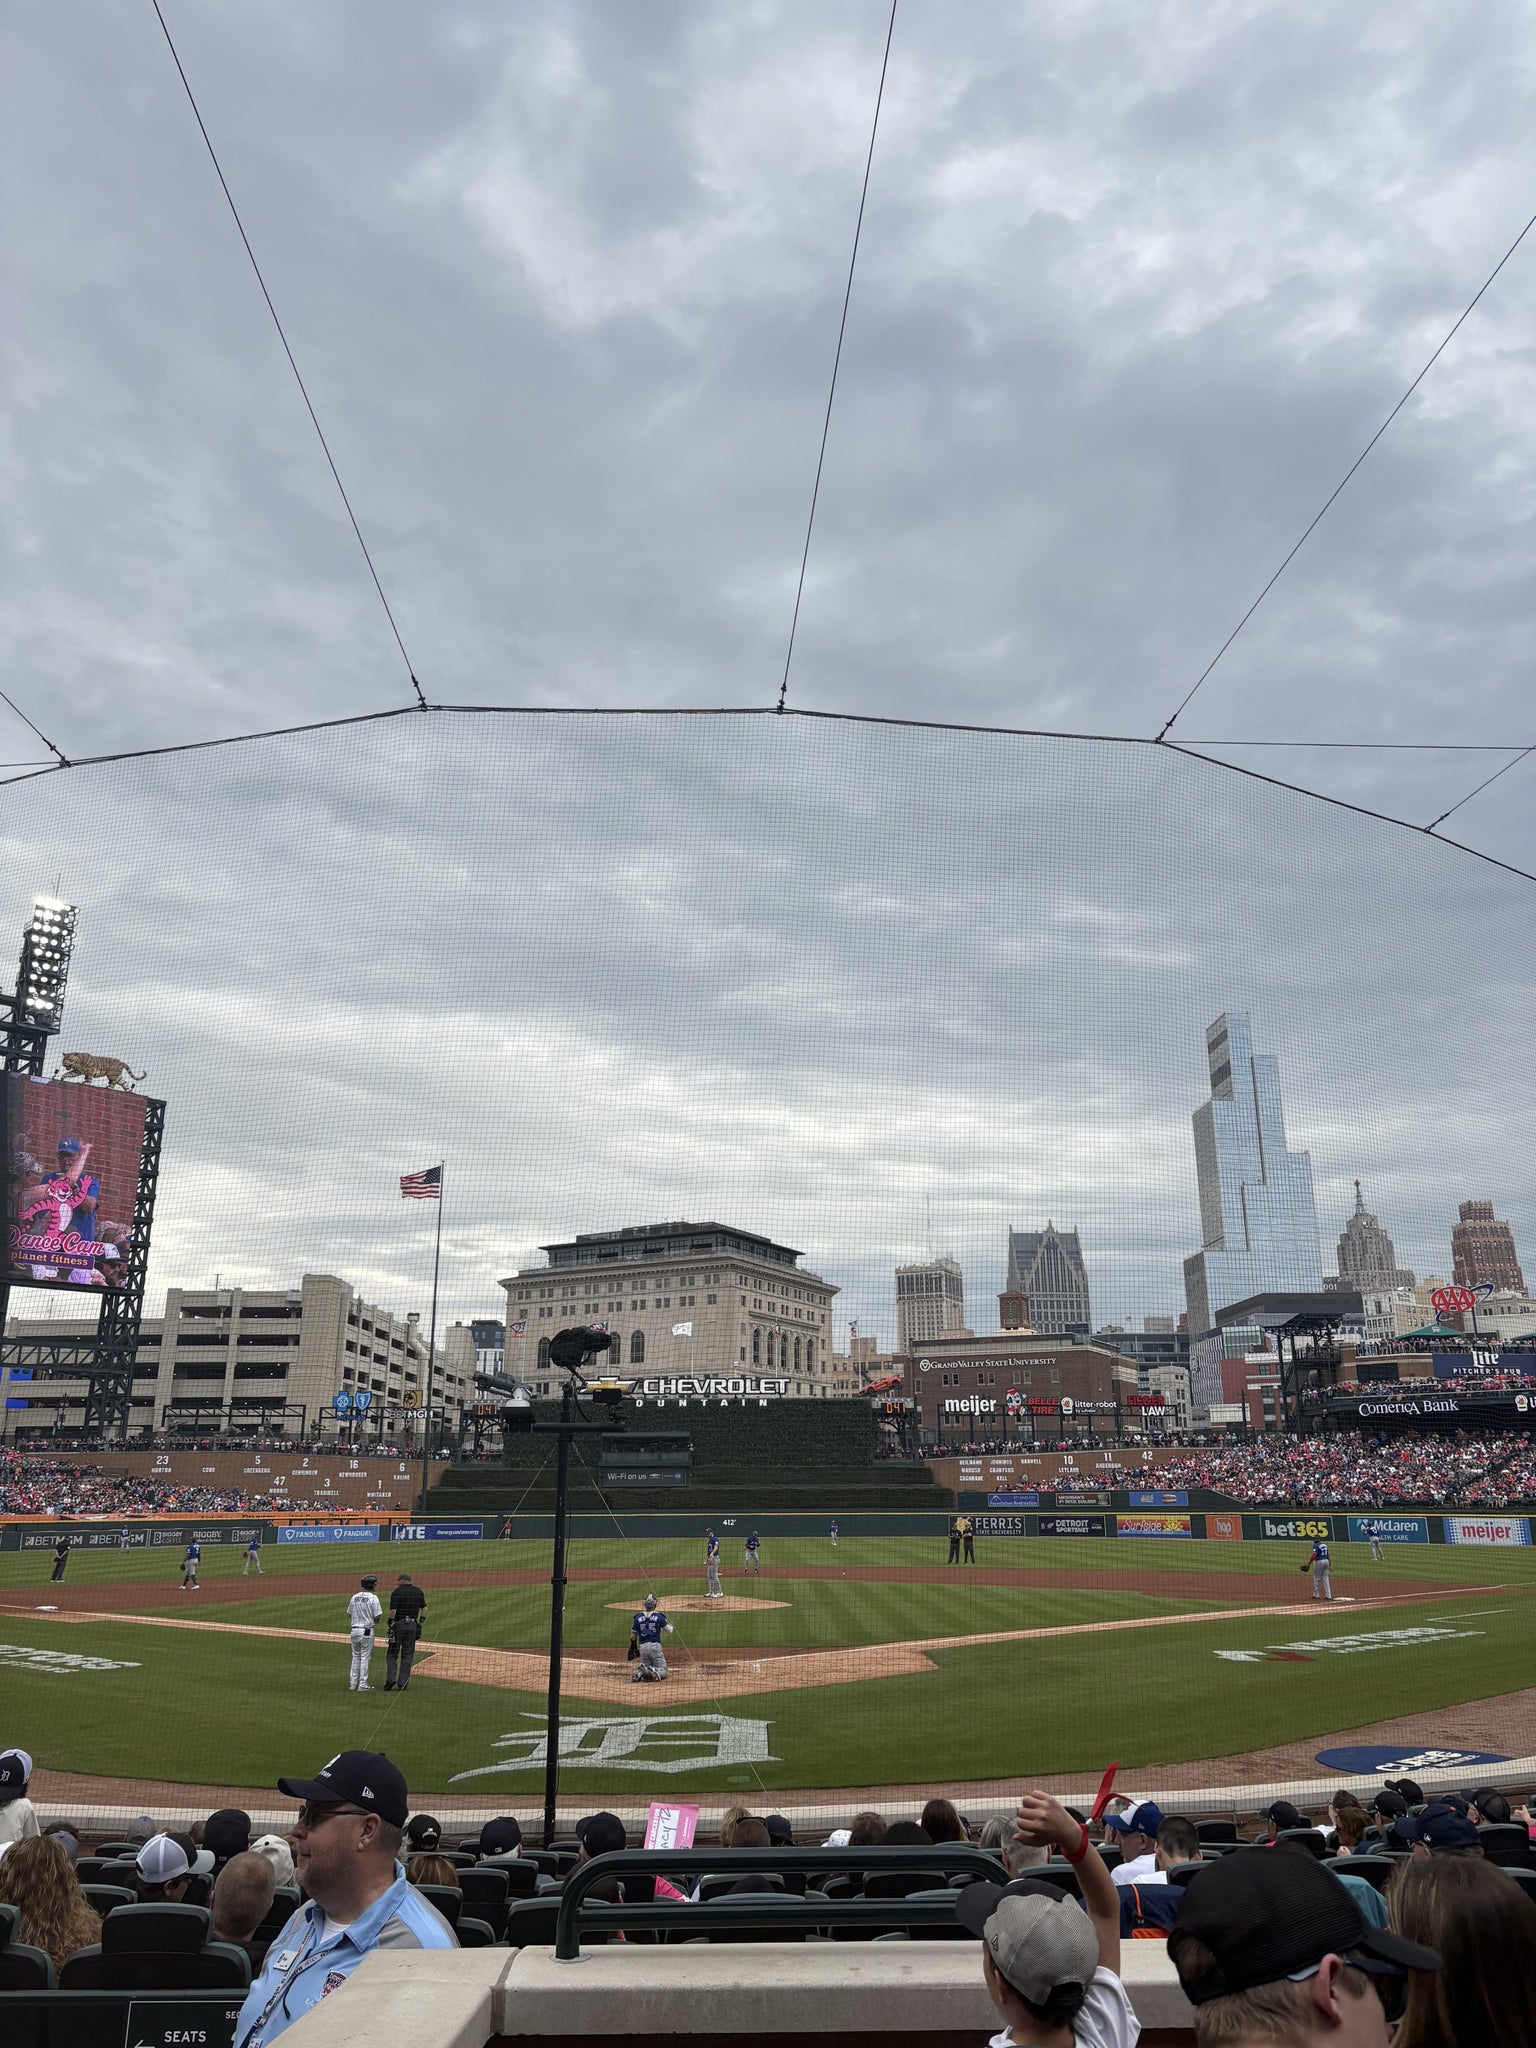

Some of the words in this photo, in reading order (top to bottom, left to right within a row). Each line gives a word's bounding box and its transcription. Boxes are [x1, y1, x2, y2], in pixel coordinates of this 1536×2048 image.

[9, 1224, 61, 1251] Dance
[62, 1231, 104, 1255] Cam
[11, 1251, 47, 1262] planet
[50, 1254, 88, 1266] fitness
[1435, 1287, 1472, 1311] AAA
[1472, 1350, 1499, 1368] Lite
[1452, 1367, 1500, 1376] PITCHER'S
[1503, 1367, 1521, 1375] PUB
[643, 1378, 791, 1395] CHEVROLET
[635, 1399, 768, 1407] OUNTAIN
[944, 1395, 997, 1416] meijer
[1027, 1397, 1058, 1405] BELLE
[1127, 1395, 1165, 1406] FIEGER
[1031, 1406, 1055, 1414] TIRE
[1141, 1406, 1165, 1416] LAW
[1423, 1399, 1460, 1413] Bank
[156, 1455, 169, 1465] 23
[1063, 1455, 1074, 1465] 10
[1103, 1452, 1112, 1461] 11
[1141, 1451, 1153, 1460] 42
[349, 1459, 359, 1469] 16
[273, 1476, 286, 1486] 47
[607, 1472, 626, 1480] Wi-Fi
[975, 1517, 1022, 1529] FERRIS
[1055, 1519, 1089, 1527] DETROIT
[1122, 1518, 1162, 1532] Surfside
[1373, 1519, 1418, 1531] McLaren
[343, 1529, 373, 1537] FANDUEL
[395, 1526, 426, 1540] DTE
[1264, 1519, 1329, 1538] bet365
[1461, 1521, 1511, 1543] meijer
[192, 1530, 222, 1538] BIGGBY
[295, 1530, 325, 1538] FANDUEL
[660, 1826, 677, 1849] ACY
[164, 2030, 207, 2043] SEATS
